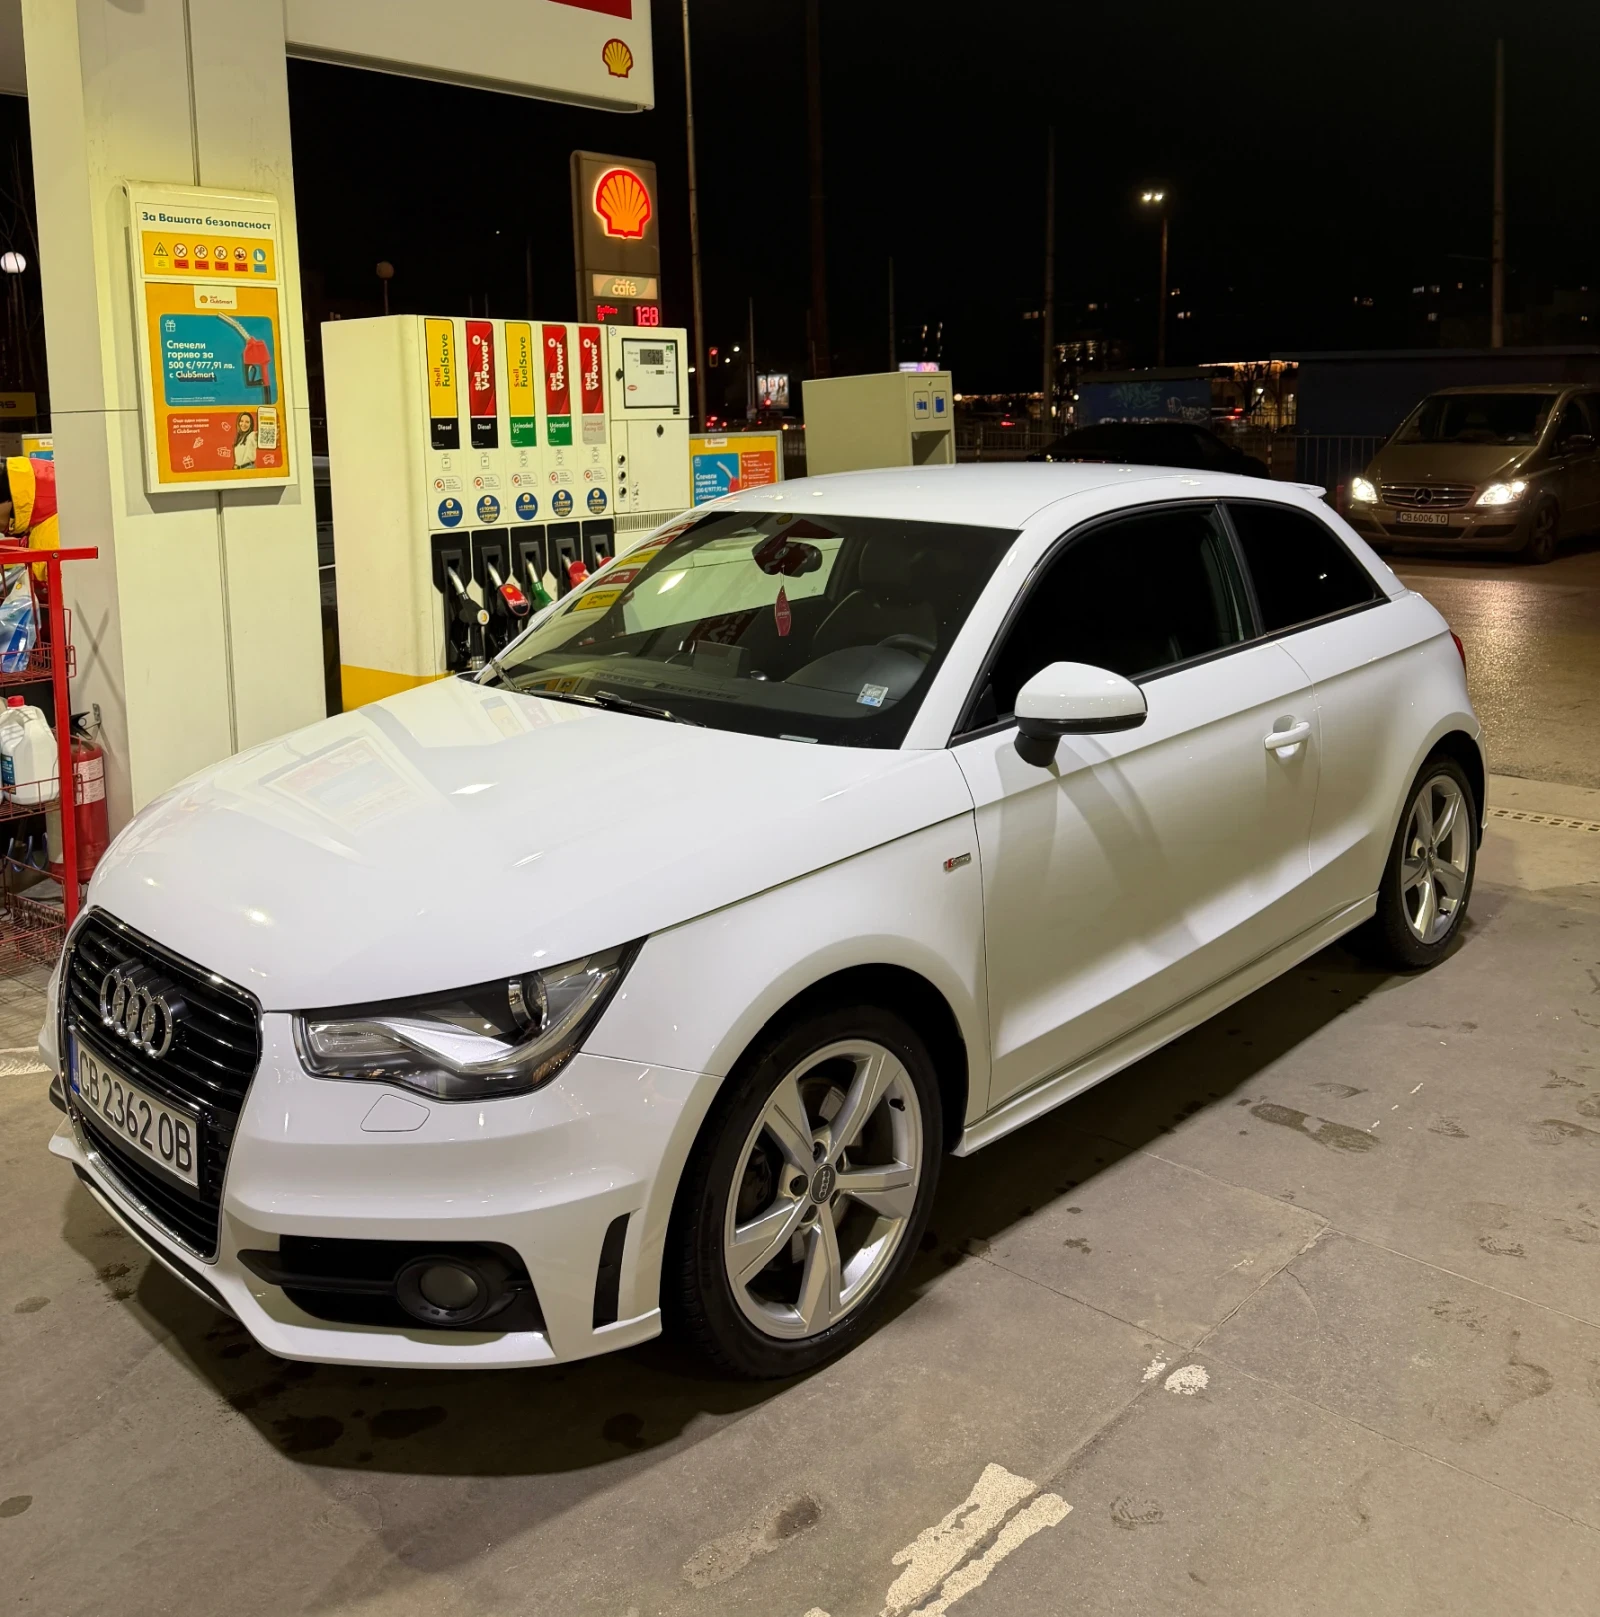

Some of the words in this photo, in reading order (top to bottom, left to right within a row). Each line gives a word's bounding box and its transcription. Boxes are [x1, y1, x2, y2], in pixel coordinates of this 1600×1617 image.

[142, 211, 156, 222] За
[158, 213, 203, 225] Вашата
[205, 216, 272, 230] безопасност
[612, 280, 637, 296] café
[635, 306, 659, 326] 128
[166, 340, 206, 350] Спечели
[167, 351, 201, 361] гориво
[202, 351, 214, 359] за
[168, 361, 185, 369] 500
[440, 333, 451, 387] FuelSave
[481, 339, 490, 391] V-Power
[519, 336, 528, 388] FuelSave
[175, 370, 215, 379] ClubSmart
[556, 342, 565, 391] V-Power
[591, 342, 599, 391] V-Power
[433, 367, 441, 387] Shell
[474, 372, 482, 391] Shell
[512, 421, 533, 429] Unleaded
[549, 421, 569, 429] Unleaded
[1401, 513, 1412, 522] CB
[1413, 513, 1433, 523] 6006
[1435, 514, 1446, 523] TO
[80, 1050, 99, 1106] CB
[102, 1072, 153, 1151] 2362
[158, 1112, 192, 1172] OB
